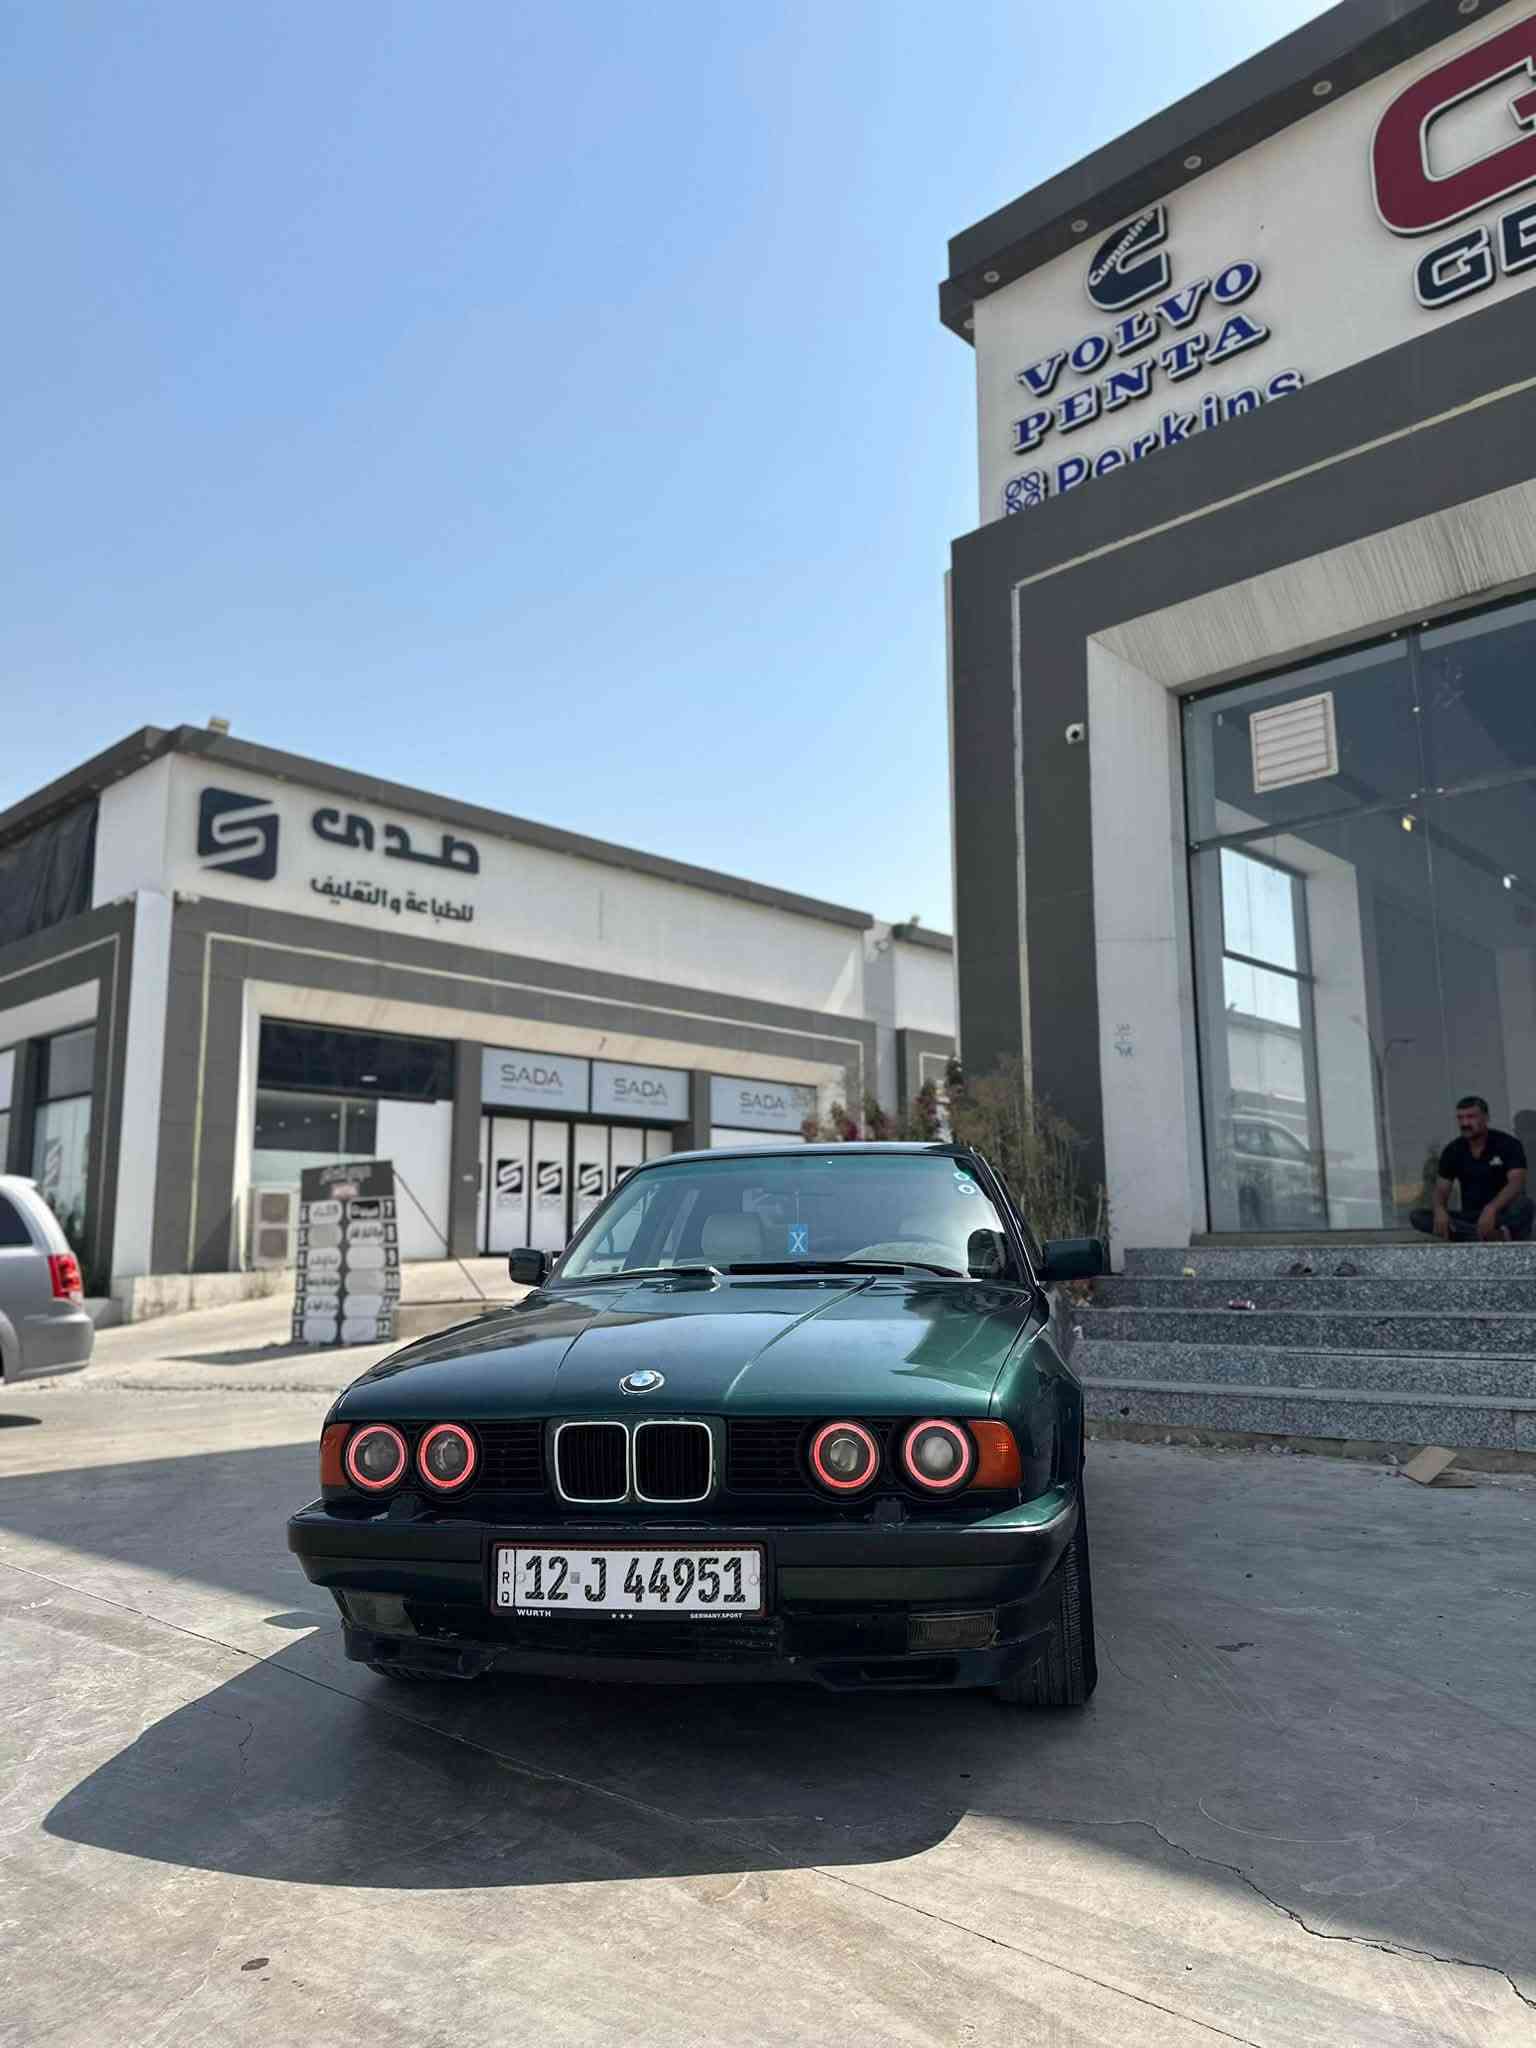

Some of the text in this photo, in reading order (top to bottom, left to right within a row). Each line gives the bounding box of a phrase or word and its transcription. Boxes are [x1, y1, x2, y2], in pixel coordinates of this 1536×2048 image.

[1089, 210, 1155, 286] Cummins
[1017, 261, 1260, 396] VOLVO
[1013, 312, 1268, 453] PENTA
[312, 807, 480, 875] صدى
[405, 890, 475, 924] للطباعة
[500, 1063, 563, 1088] SADA
[613, 1077, 668, 1099] SADA
[739, 1091, 785, 1110] SADA
[525, 1556, 746, 1602] 12 J 44951
[517, 1608, 552, 1617] WURTH
